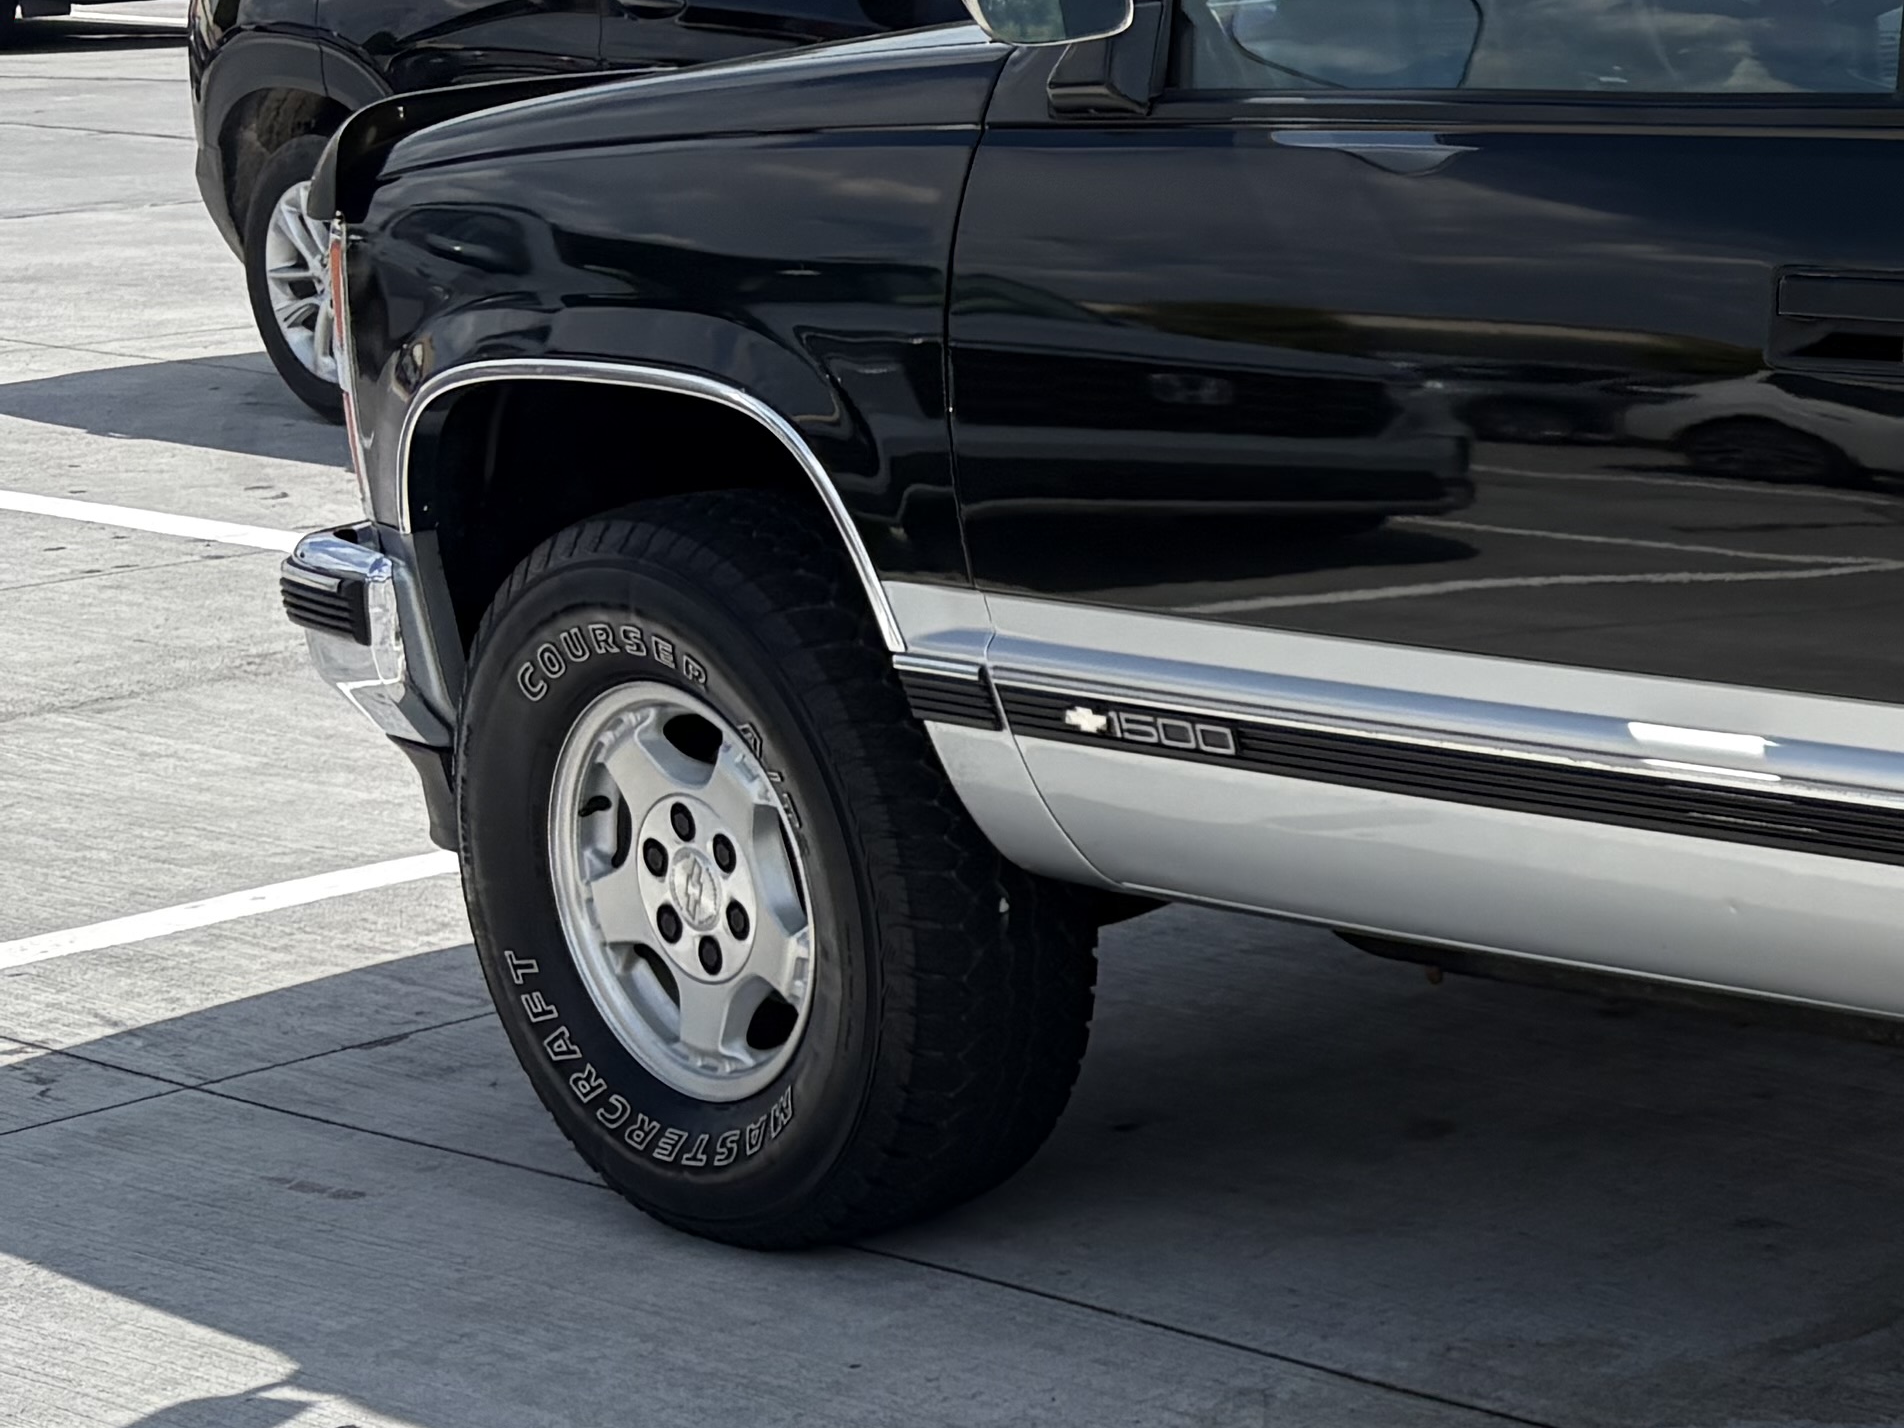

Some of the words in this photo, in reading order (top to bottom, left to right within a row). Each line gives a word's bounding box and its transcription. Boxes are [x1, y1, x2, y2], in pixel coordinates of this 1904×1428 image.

[517, 624, 708, 701] COURSER
[1108, 710, 1236, 755] 1500
[504, 950, 793, 1166] MASTERCRAFT
